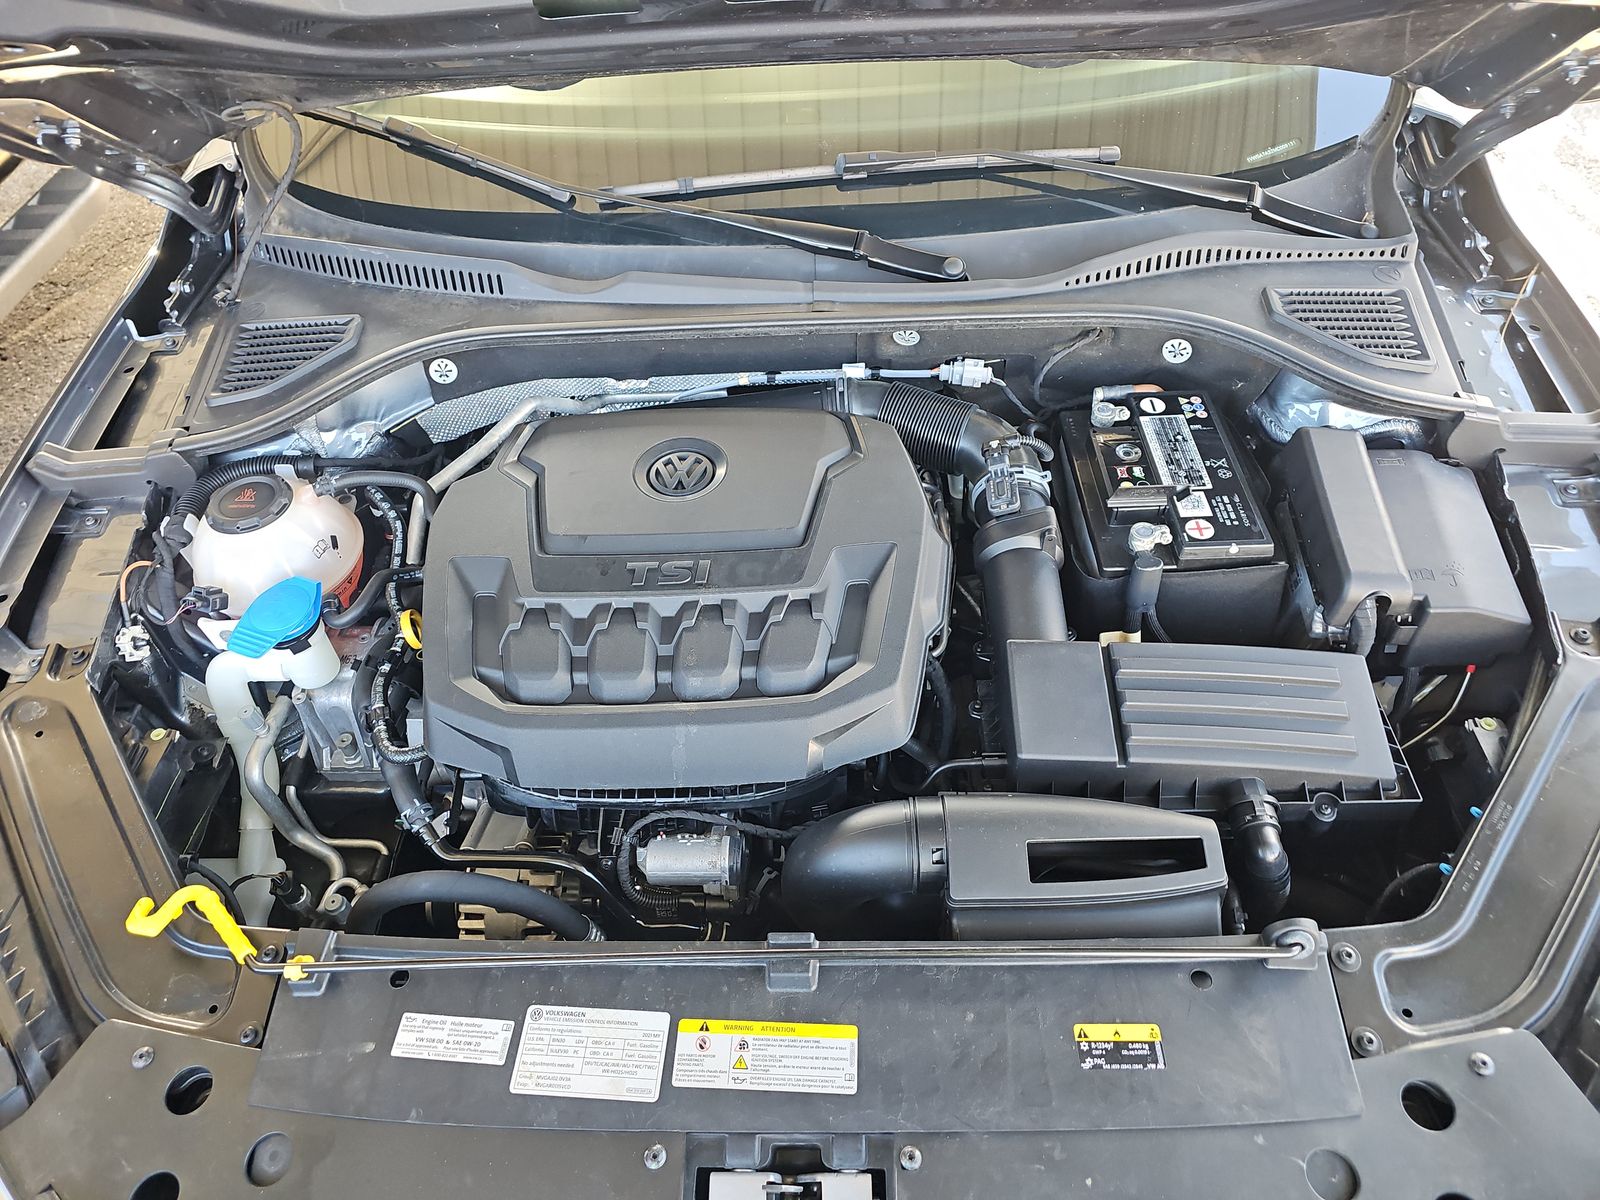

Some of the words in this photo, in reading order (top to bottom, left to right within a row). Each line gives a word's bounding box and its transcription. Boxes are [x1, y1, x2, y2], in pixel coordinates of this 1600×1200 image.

[1236, 503, 1250, 526] CLARIOS
[626, 560, 712, 585] TSI
[761, 1025, 796, 1033] ATTENTION
[1091, 1042, 1113, 1050] R-1234yf
[529, 1060, 556, 1068] adjustments
